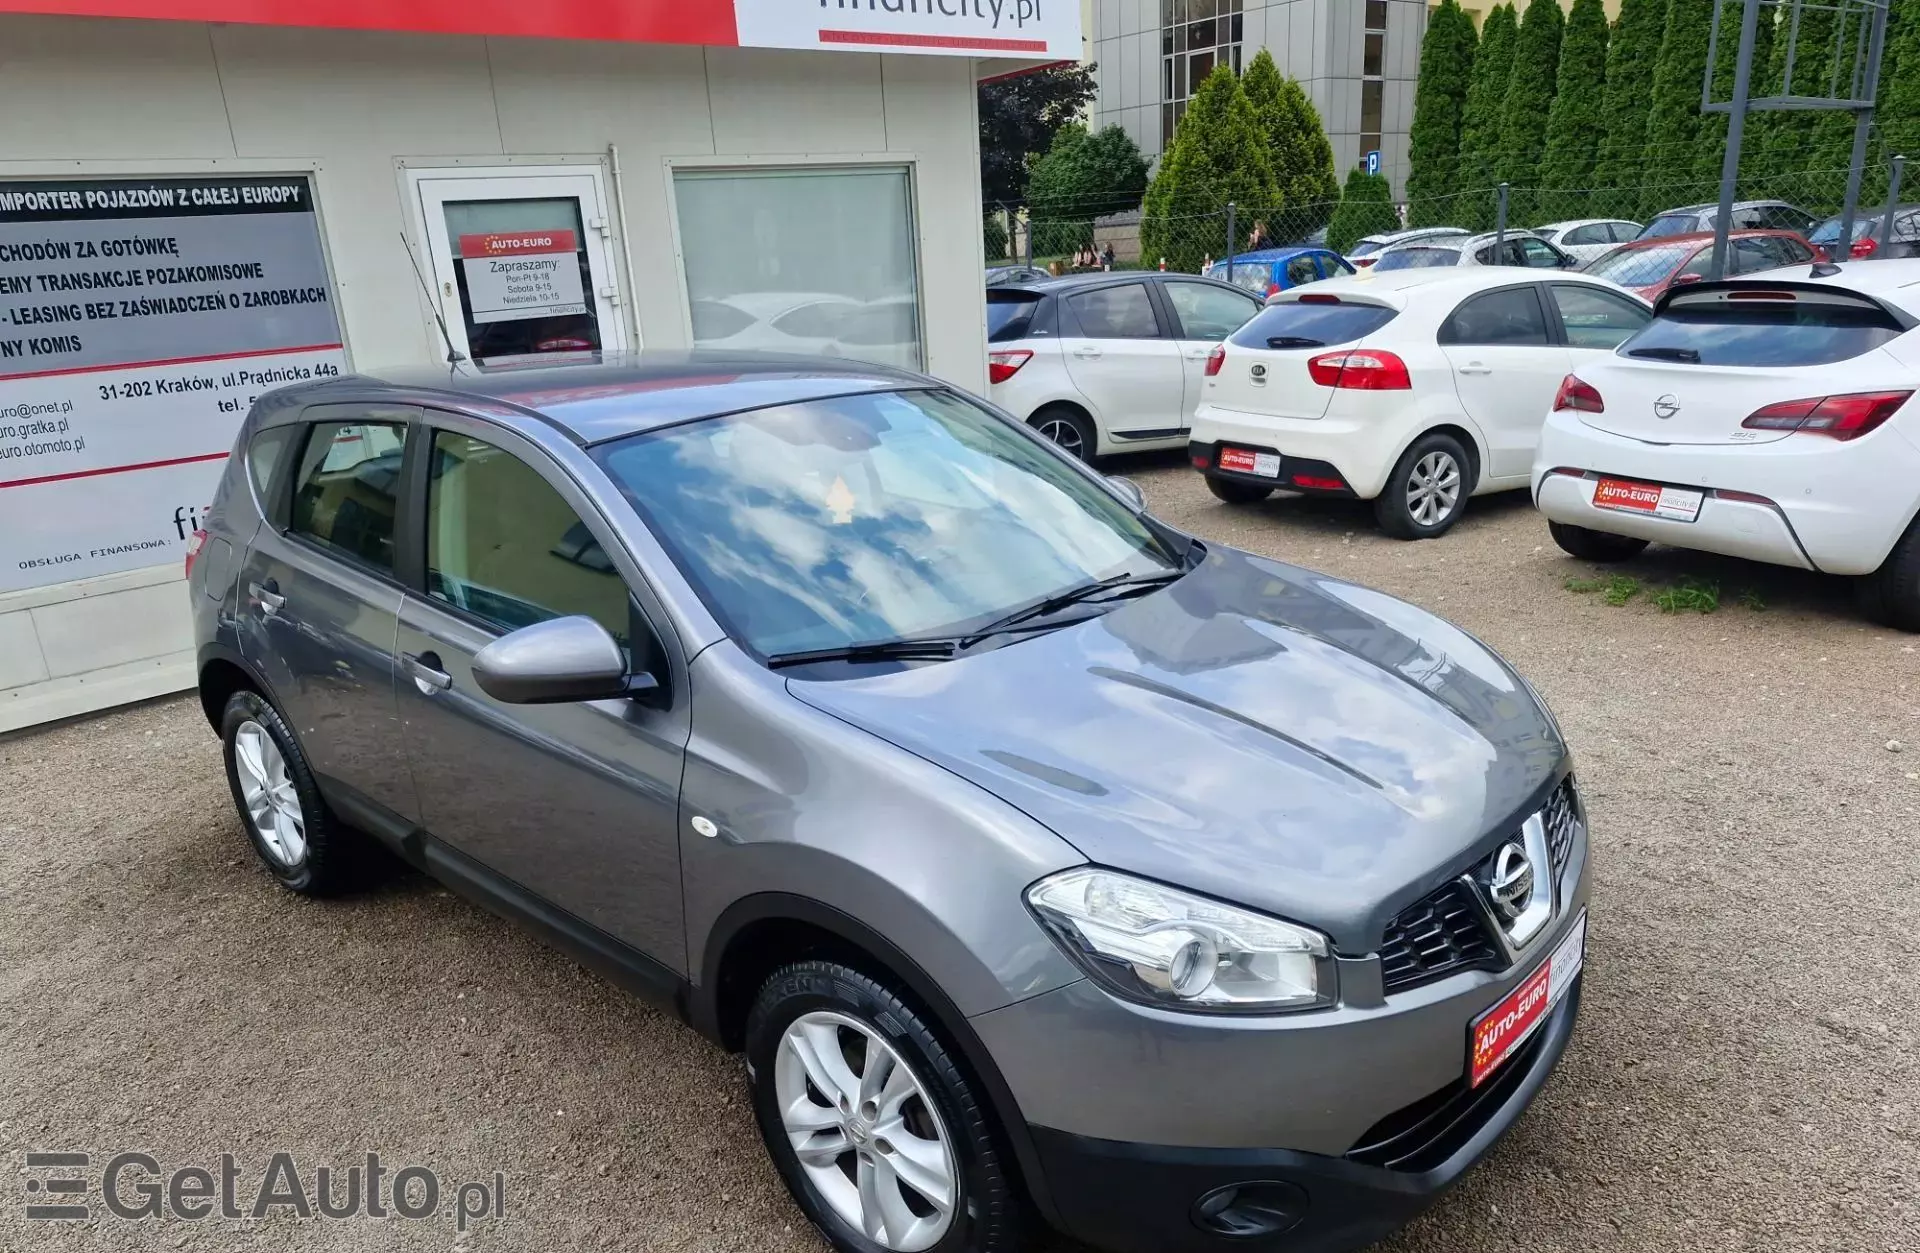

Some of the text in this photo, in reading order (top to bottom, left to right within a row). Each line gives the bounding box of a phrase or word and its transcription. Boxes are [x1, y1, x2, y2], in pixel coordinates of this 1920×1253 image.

[1369, 154, 1377, 175] P
[0, 185, 299, 211] MPORTER POJAZDÓW Z CAŁEJ EUROPY
[0, 235, 179, 262] CHODÓW ZA GOTÓWKĘ
[491, 237, 552, 249] AUTO-EURO
[490, 259, 560, 274] Zapraszamy:
[0, 262, 264, 295] EMY TRANSAKCJE POZAKOMISOWE
[10, 303, 83, 325] LEASING
[85, 301, 118, 320] BEZ
[120, 291, 227, 317] ZAŚWIADCZEŃ
[230, 292, 240, 308] O
[244, 287, 327, 308] ZAROBKACH
[28, 335, 82, 355] KOMIS
[99, 363, 339, 400] 31-202 Kraków, ul.Prądnicka 44a
[217, 398, 244, 413] tel.
[1223, 455, 1254, 465] AUTO-EURO
[1602, 486, 1659, 503] AUTO-EURO
[18, 538, 172, 570] OBSŁUGA FINANSOWA:
[1480, 979, 1547, 1054] AUTO-EURO
